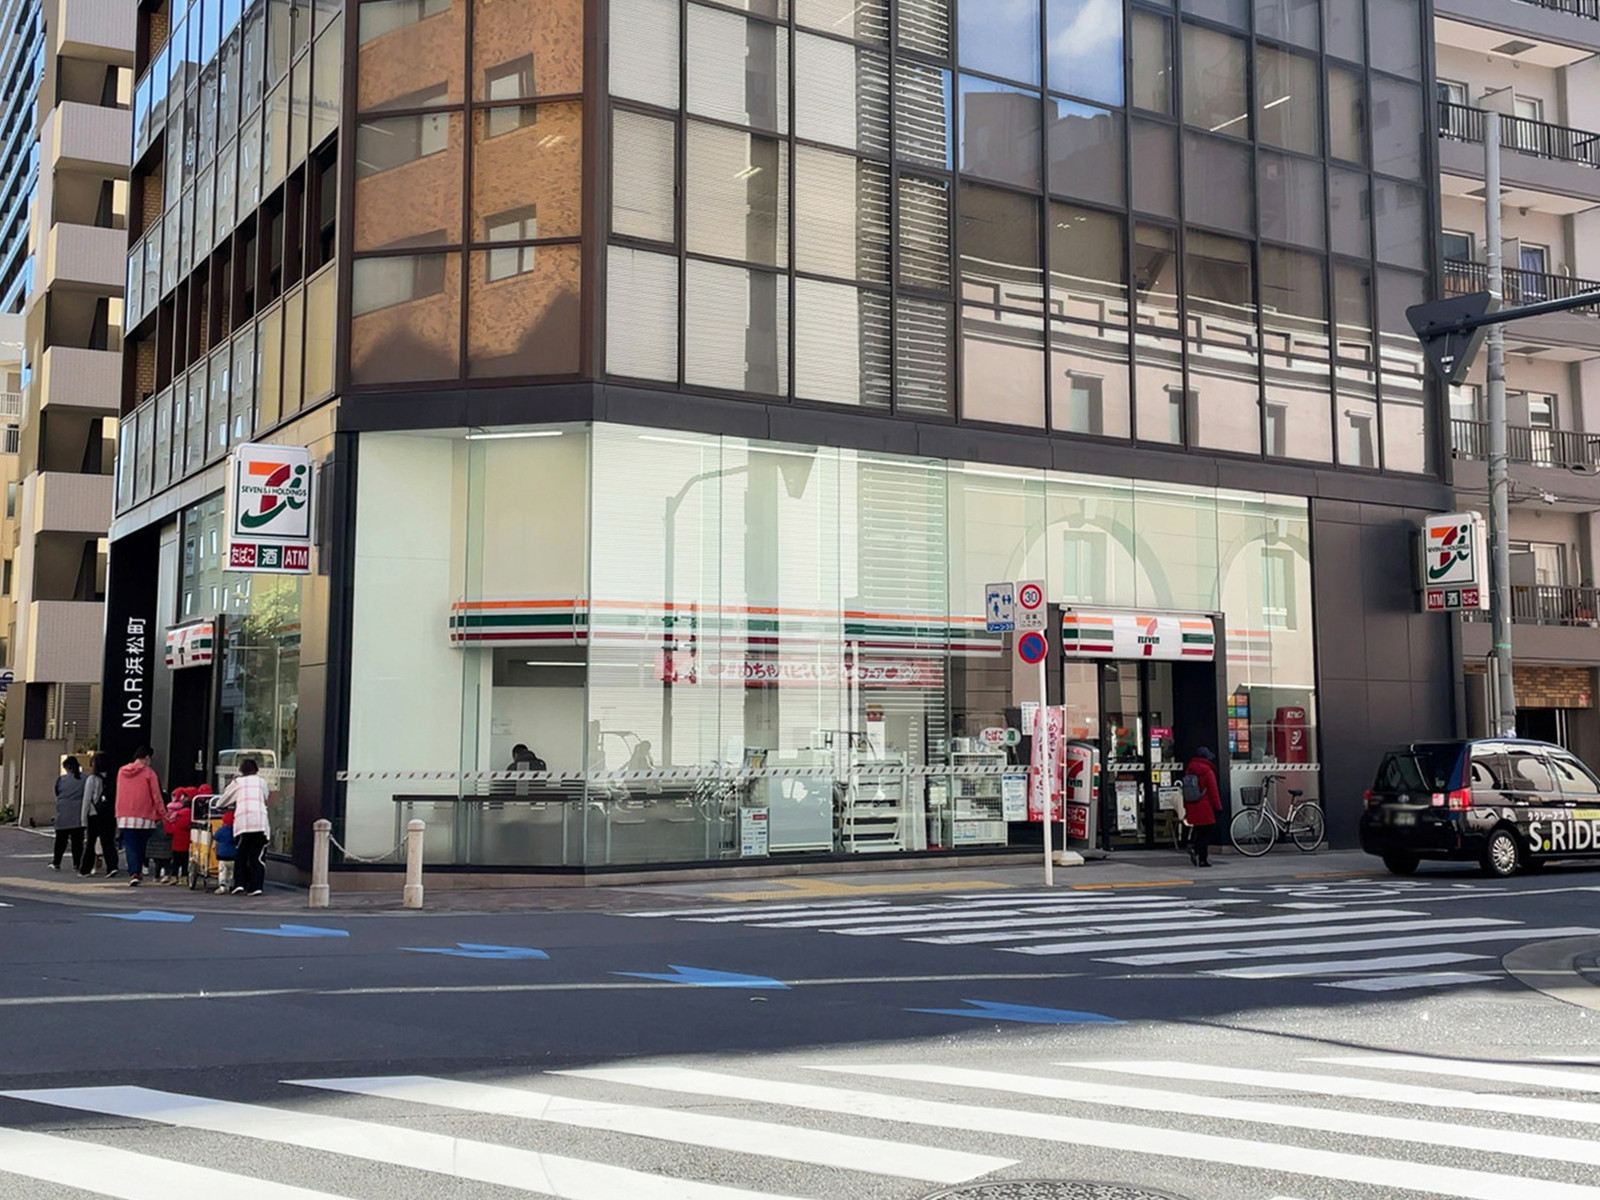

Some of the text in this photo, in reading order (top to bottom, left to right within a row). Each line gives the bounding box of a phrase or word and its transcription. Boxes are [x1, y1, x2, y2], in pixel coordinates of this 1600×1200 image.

[272, 488, 307, 497] HOLDINGS
[231, 547, 308, 567] たばこ 酒 ATM
[1025, 591, 1038, 603] 30
[1428, 594, 1444, 607] ATM
[1529, 820, 1600, 852] S.RIDE
